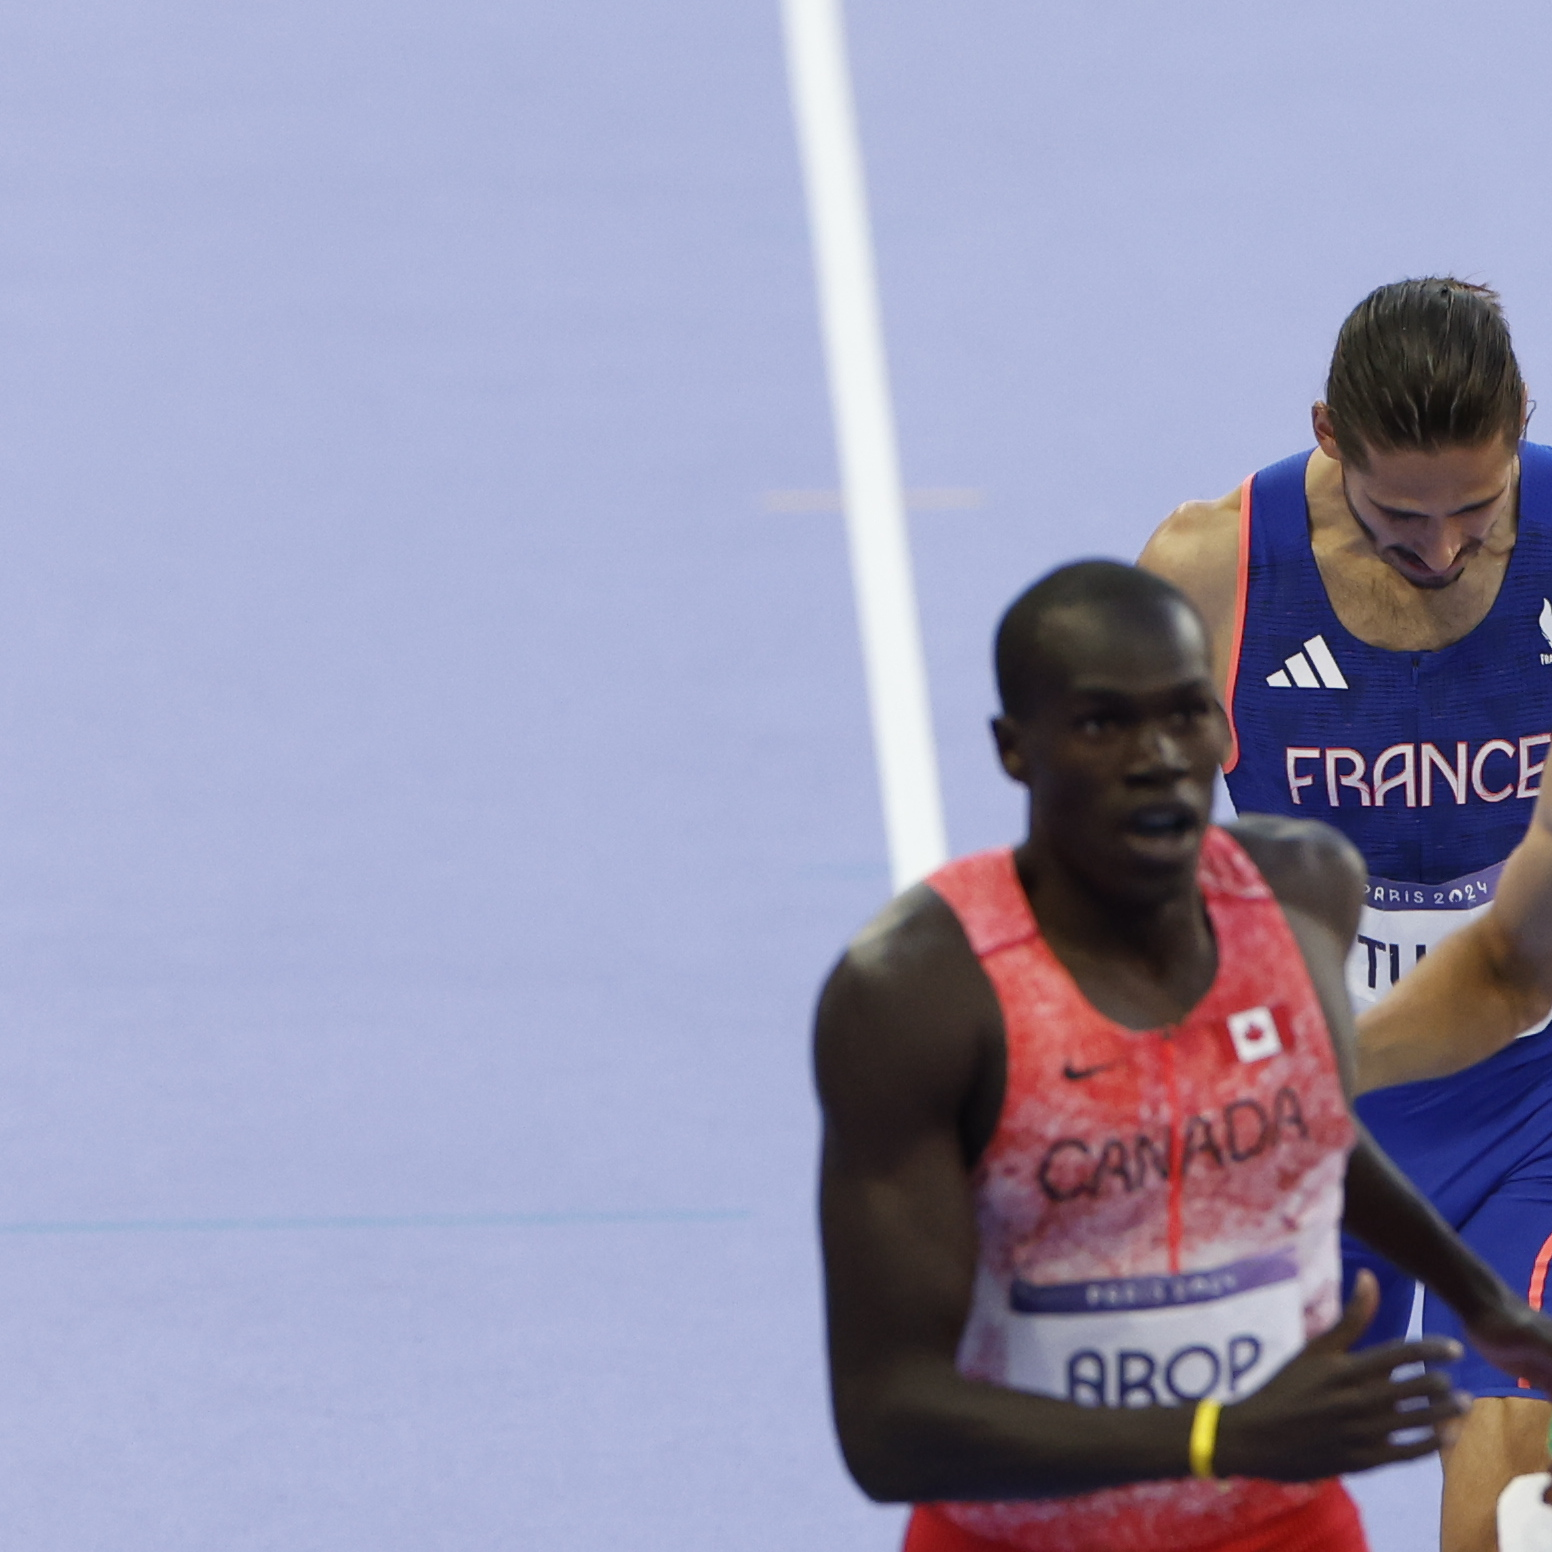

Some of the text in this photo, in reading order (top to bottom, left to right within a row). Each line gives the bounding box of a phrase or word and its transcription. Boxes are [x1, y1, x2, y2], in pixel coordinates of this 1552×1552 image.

[1286, 733, 1552, 808] FRANCE
[1434, 881, 1488, 905] 2024
[1037, 1087, 1309, 1200] CANADA
[1067, 1334, 1262, 1408] AROP
